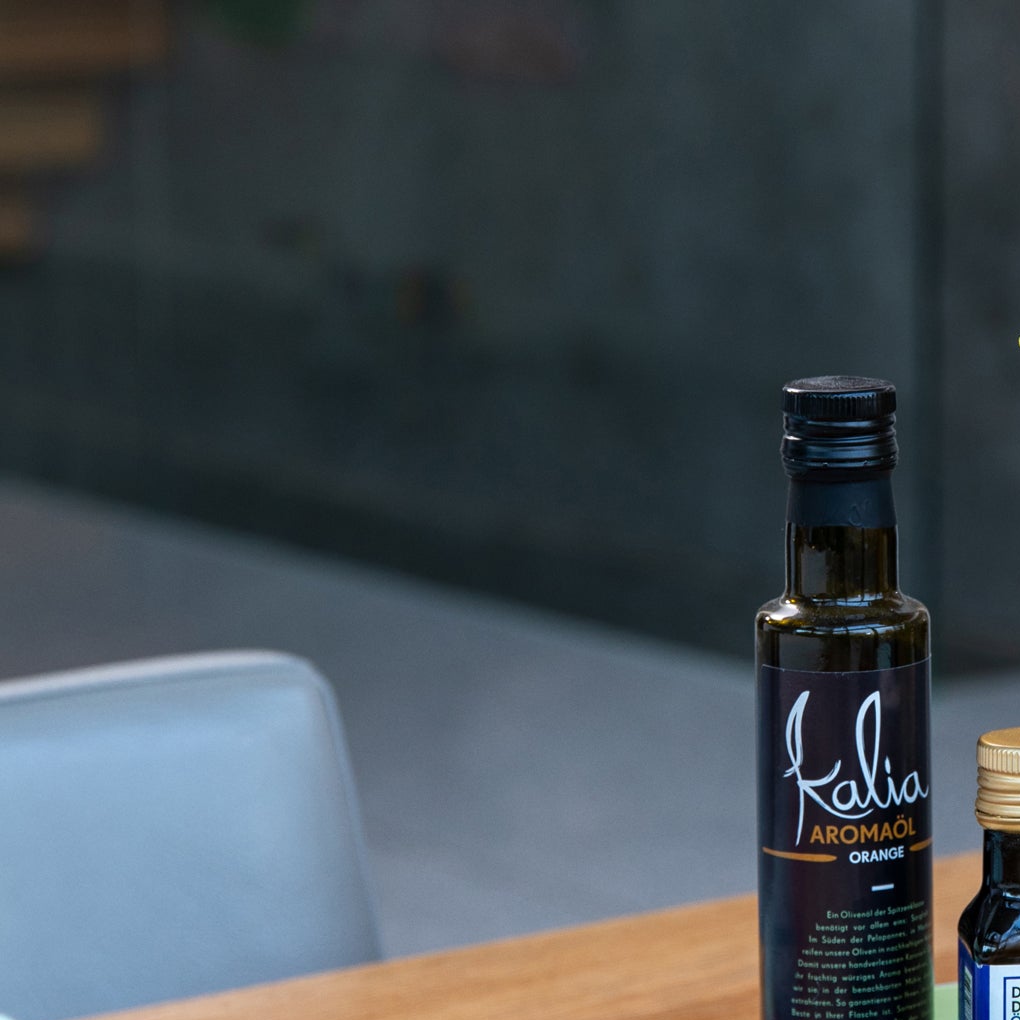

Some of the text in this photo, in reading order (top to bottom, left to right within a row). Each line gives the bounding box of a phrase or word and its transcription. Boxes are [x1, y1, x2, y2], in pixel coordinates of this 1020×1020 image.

[783, 690, 929, 847] Kalia
[809, 814, 916, 844] AROMAÖL
[849, 845, 905, 864] ORANGE
[827, 910, 839, 919] Ein
[840, 908, 873, 919] Olivenöl
[874, 907, 887, 918] der
[815, 922, 849, 934] benötigt
[869, 920, 889, 930] allem
[808, 935, 818, 943] Im
[821, 935, 846, 944] Süden
[850, 935, 863, 944] der
[801, 948, 823, 956] reifen
[851, 947, 877, 957] Oliven
[797, 958, 819, 968] Damit
[807, 972, 838, 983] fruchtig
[841, 974, 876, 983] würziges
[833, 986, 848, 994] der
[835, 998, 847, 1007] So
[791, 1007, 811, 1018] Beste
[825, 1010, 845, 1019] Ihrer
[848, 1009, 879, 1019] Flasche
